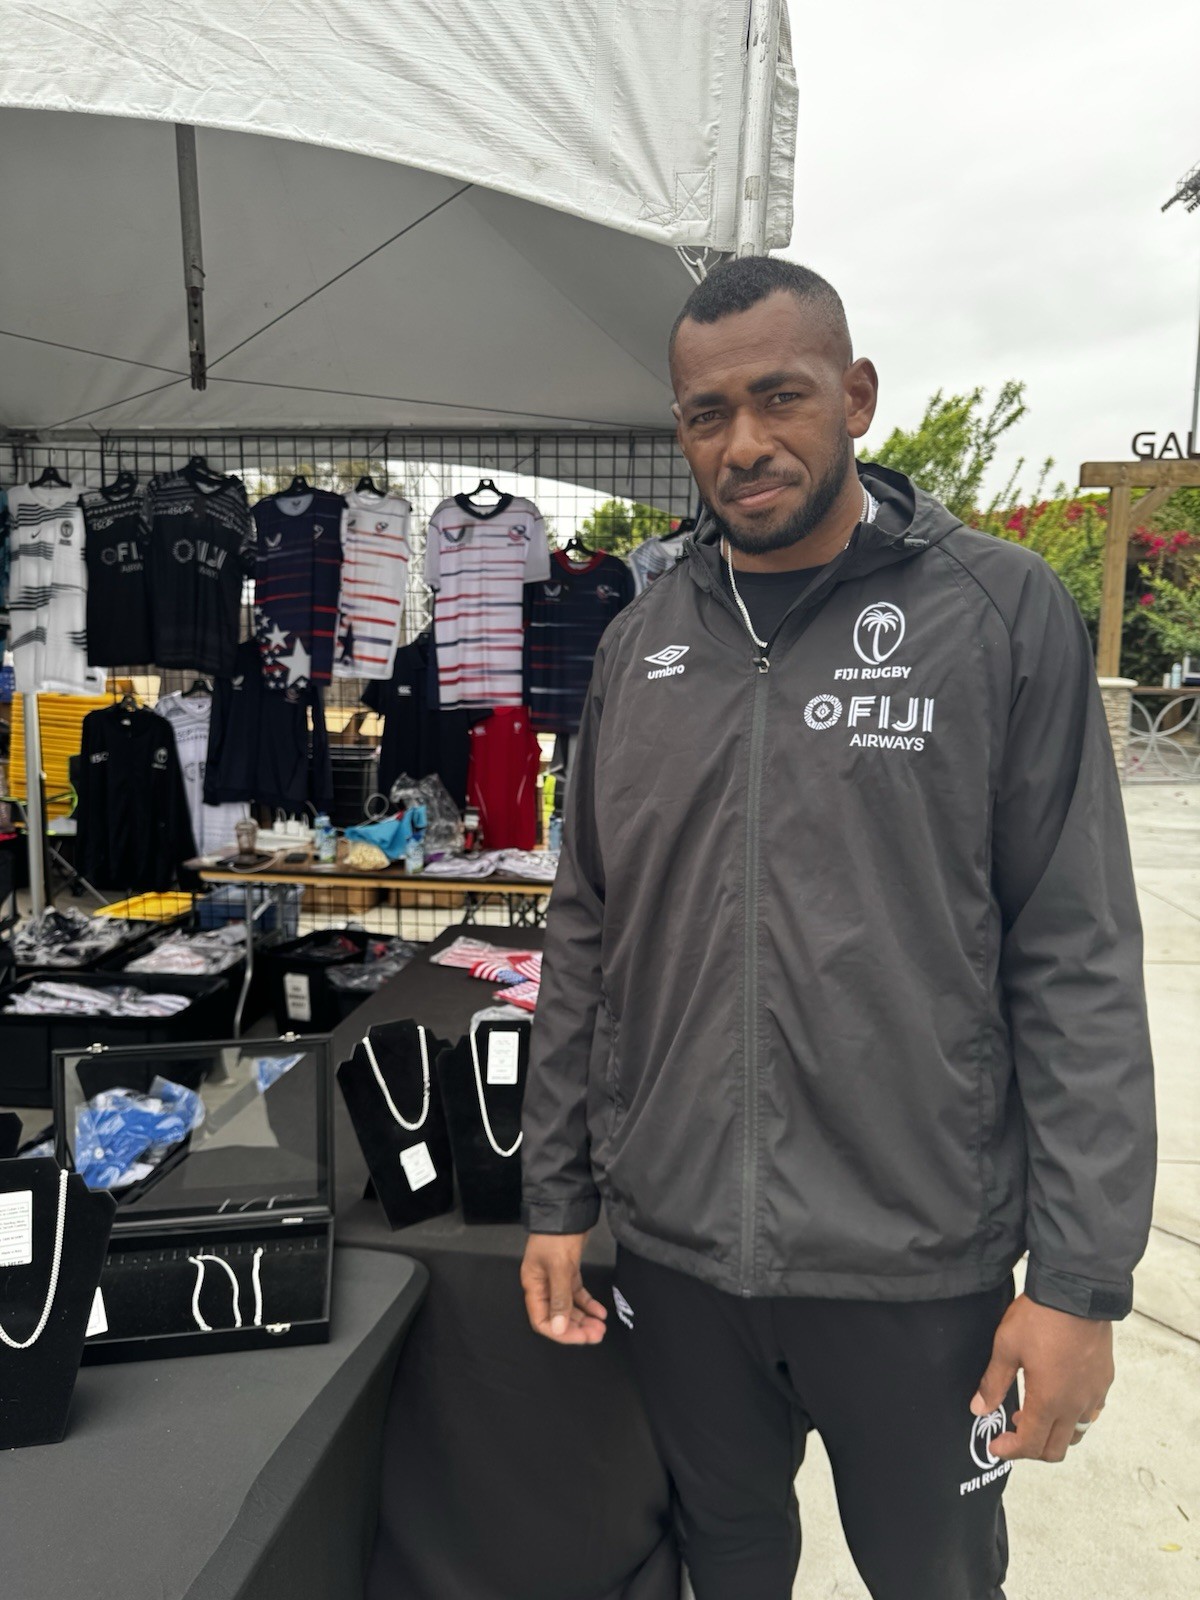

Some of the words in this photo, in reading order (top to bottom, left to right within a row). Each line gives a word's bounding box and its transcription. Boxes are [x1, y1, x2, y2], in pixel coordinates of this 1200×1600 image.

[1131, 431, 1200, 459] GAL
[647, 664, 685, 680] umbro
[834, 668, 859, 681] FIJI
[861, 666, 912, 680] RUGBY
[847, 695, 935, 733] FIJI
[849, 733, 925, 751] AIRWAYS
[960, 1477, 981, 1496] FIJI
